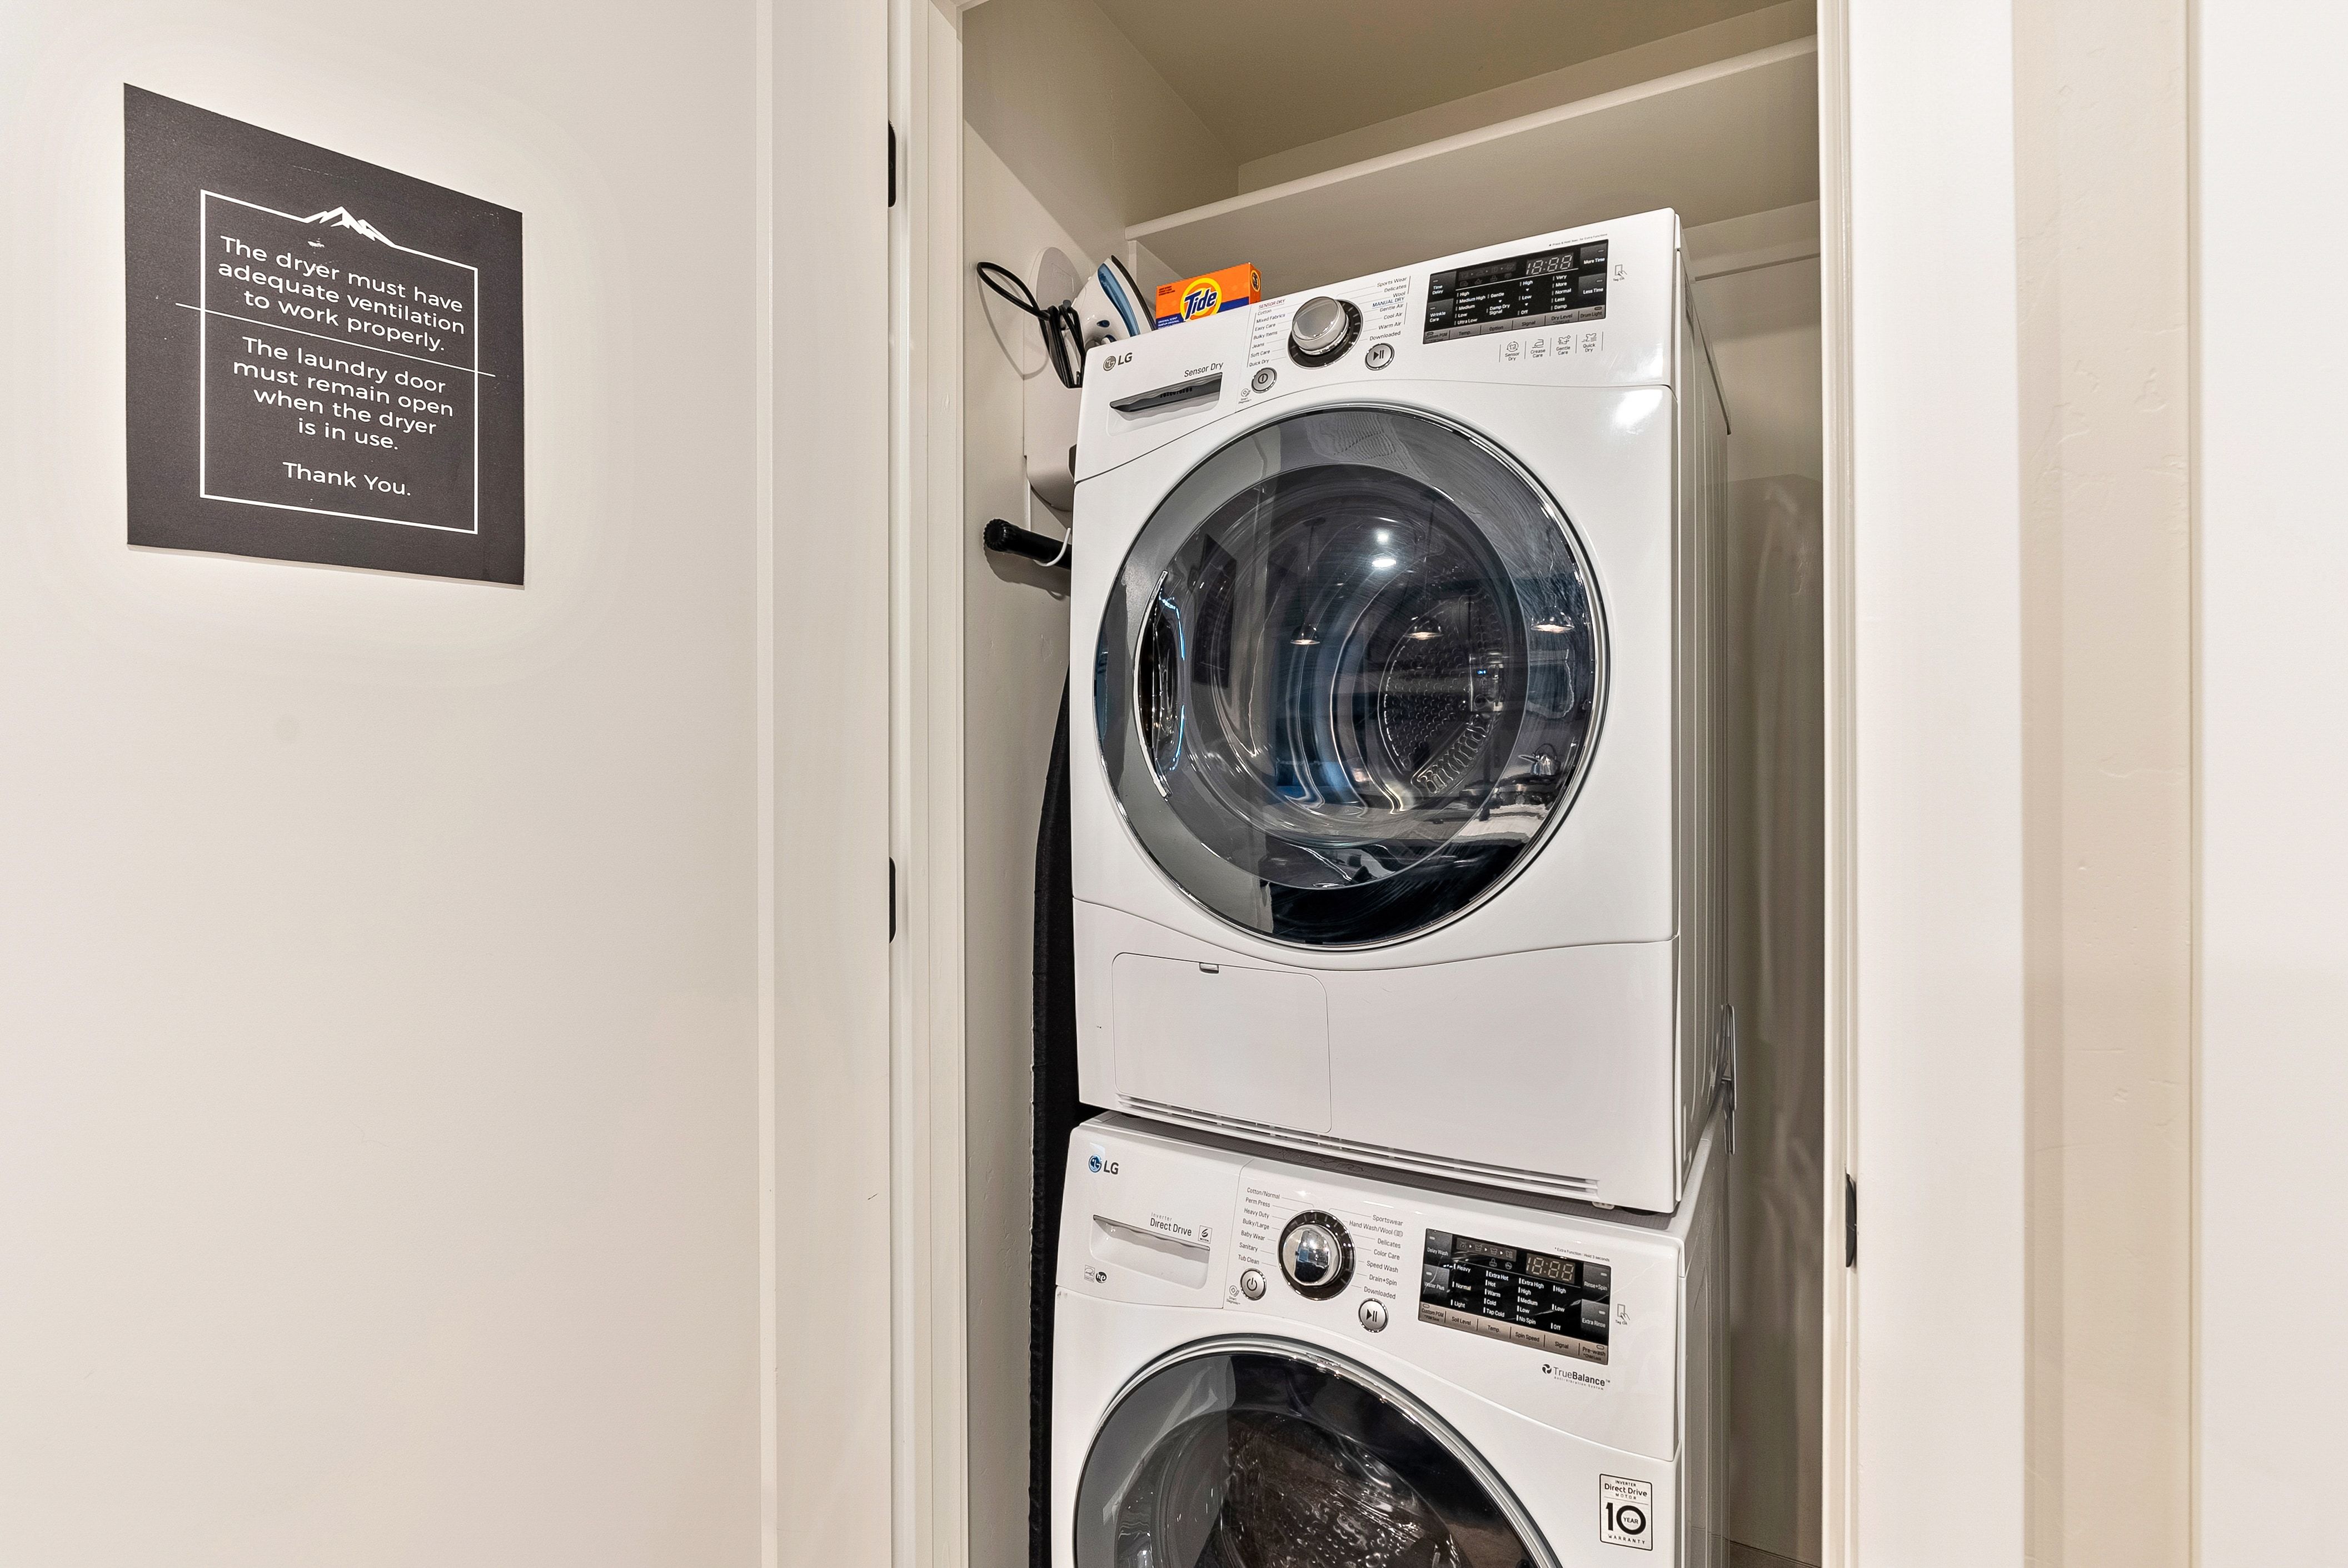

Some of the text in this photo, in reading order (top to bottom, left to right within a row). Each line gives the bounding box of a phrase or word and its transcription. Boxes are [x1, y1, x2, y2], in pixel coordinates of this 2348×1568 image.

[221, 236, 463, 312] The dryer must have
[1384, 284, 1407, 293] Delicates
[218, 263, 464, 334] adequate ventilation
[1184, 288, 1219, 321] Tide
[244, 291, 445, 352] to work properly.
[1369, 331, 1401, 341] Downloaded
[242, 336, 446, 393] The laundry door
[1118, 352, 1133, 365] LG
[1184, 362, 1224, 377] Sensor Dry
[234, 362, 453, 417] must remain open
[253, 389, 437, 435] when the dryer
[298, 417, 398, 450] is in use.
[282, 462, 411, 496] Thank You.
[1103, 1160, 1119, 1175] LG
[1247, 1187, 1280, 1200] Cotton/Normal
[1151, 1212, 1173, 1221] Inverter
[1244, 1208, 1258, 1217] Heavy
[1150, 1217, 1192, 1236] Direct Drive
[1243, 1219, 1270, 1230] Bulky/Large
[1373, 1215, 1403, 1226] Sportswear
[1349, 1220, 1393, 1235] Hand Wash/Wool
[1241, 1230, 1252, 1239] Baby
[1239, 1242, 1258, 1252] Sanitary
[1377, 1238, 1401, 1249] Delicates
[1247, 1256, 1259, 1265] Clean
[1388, 1252, 1400, 1260] Care
[1367, 1260, 1398, 1273] Speed Wash
[1457, 1265, 1471, 1273] Heavy
[1369, 1274, 1397, 1286] Drain+Spin
[1584, 1281, 1608, 1291] Rinse+Spin
[1364, 1286, 1396, 1299] Downloaded
[1455, 1282, 1472, 1291] Normal
[1520, 1297, 1538, 1306] Medium
[1554, 1341, 1569, 1350] Signal
[1582, 1347, 1606, 1356] Pre-wash
[1604, 1483, 1648, 1497] Direct Drive
[1606, 1502, 1647, 1535] 10
[1608, 1534, 1645, 1545] WARRANTY
